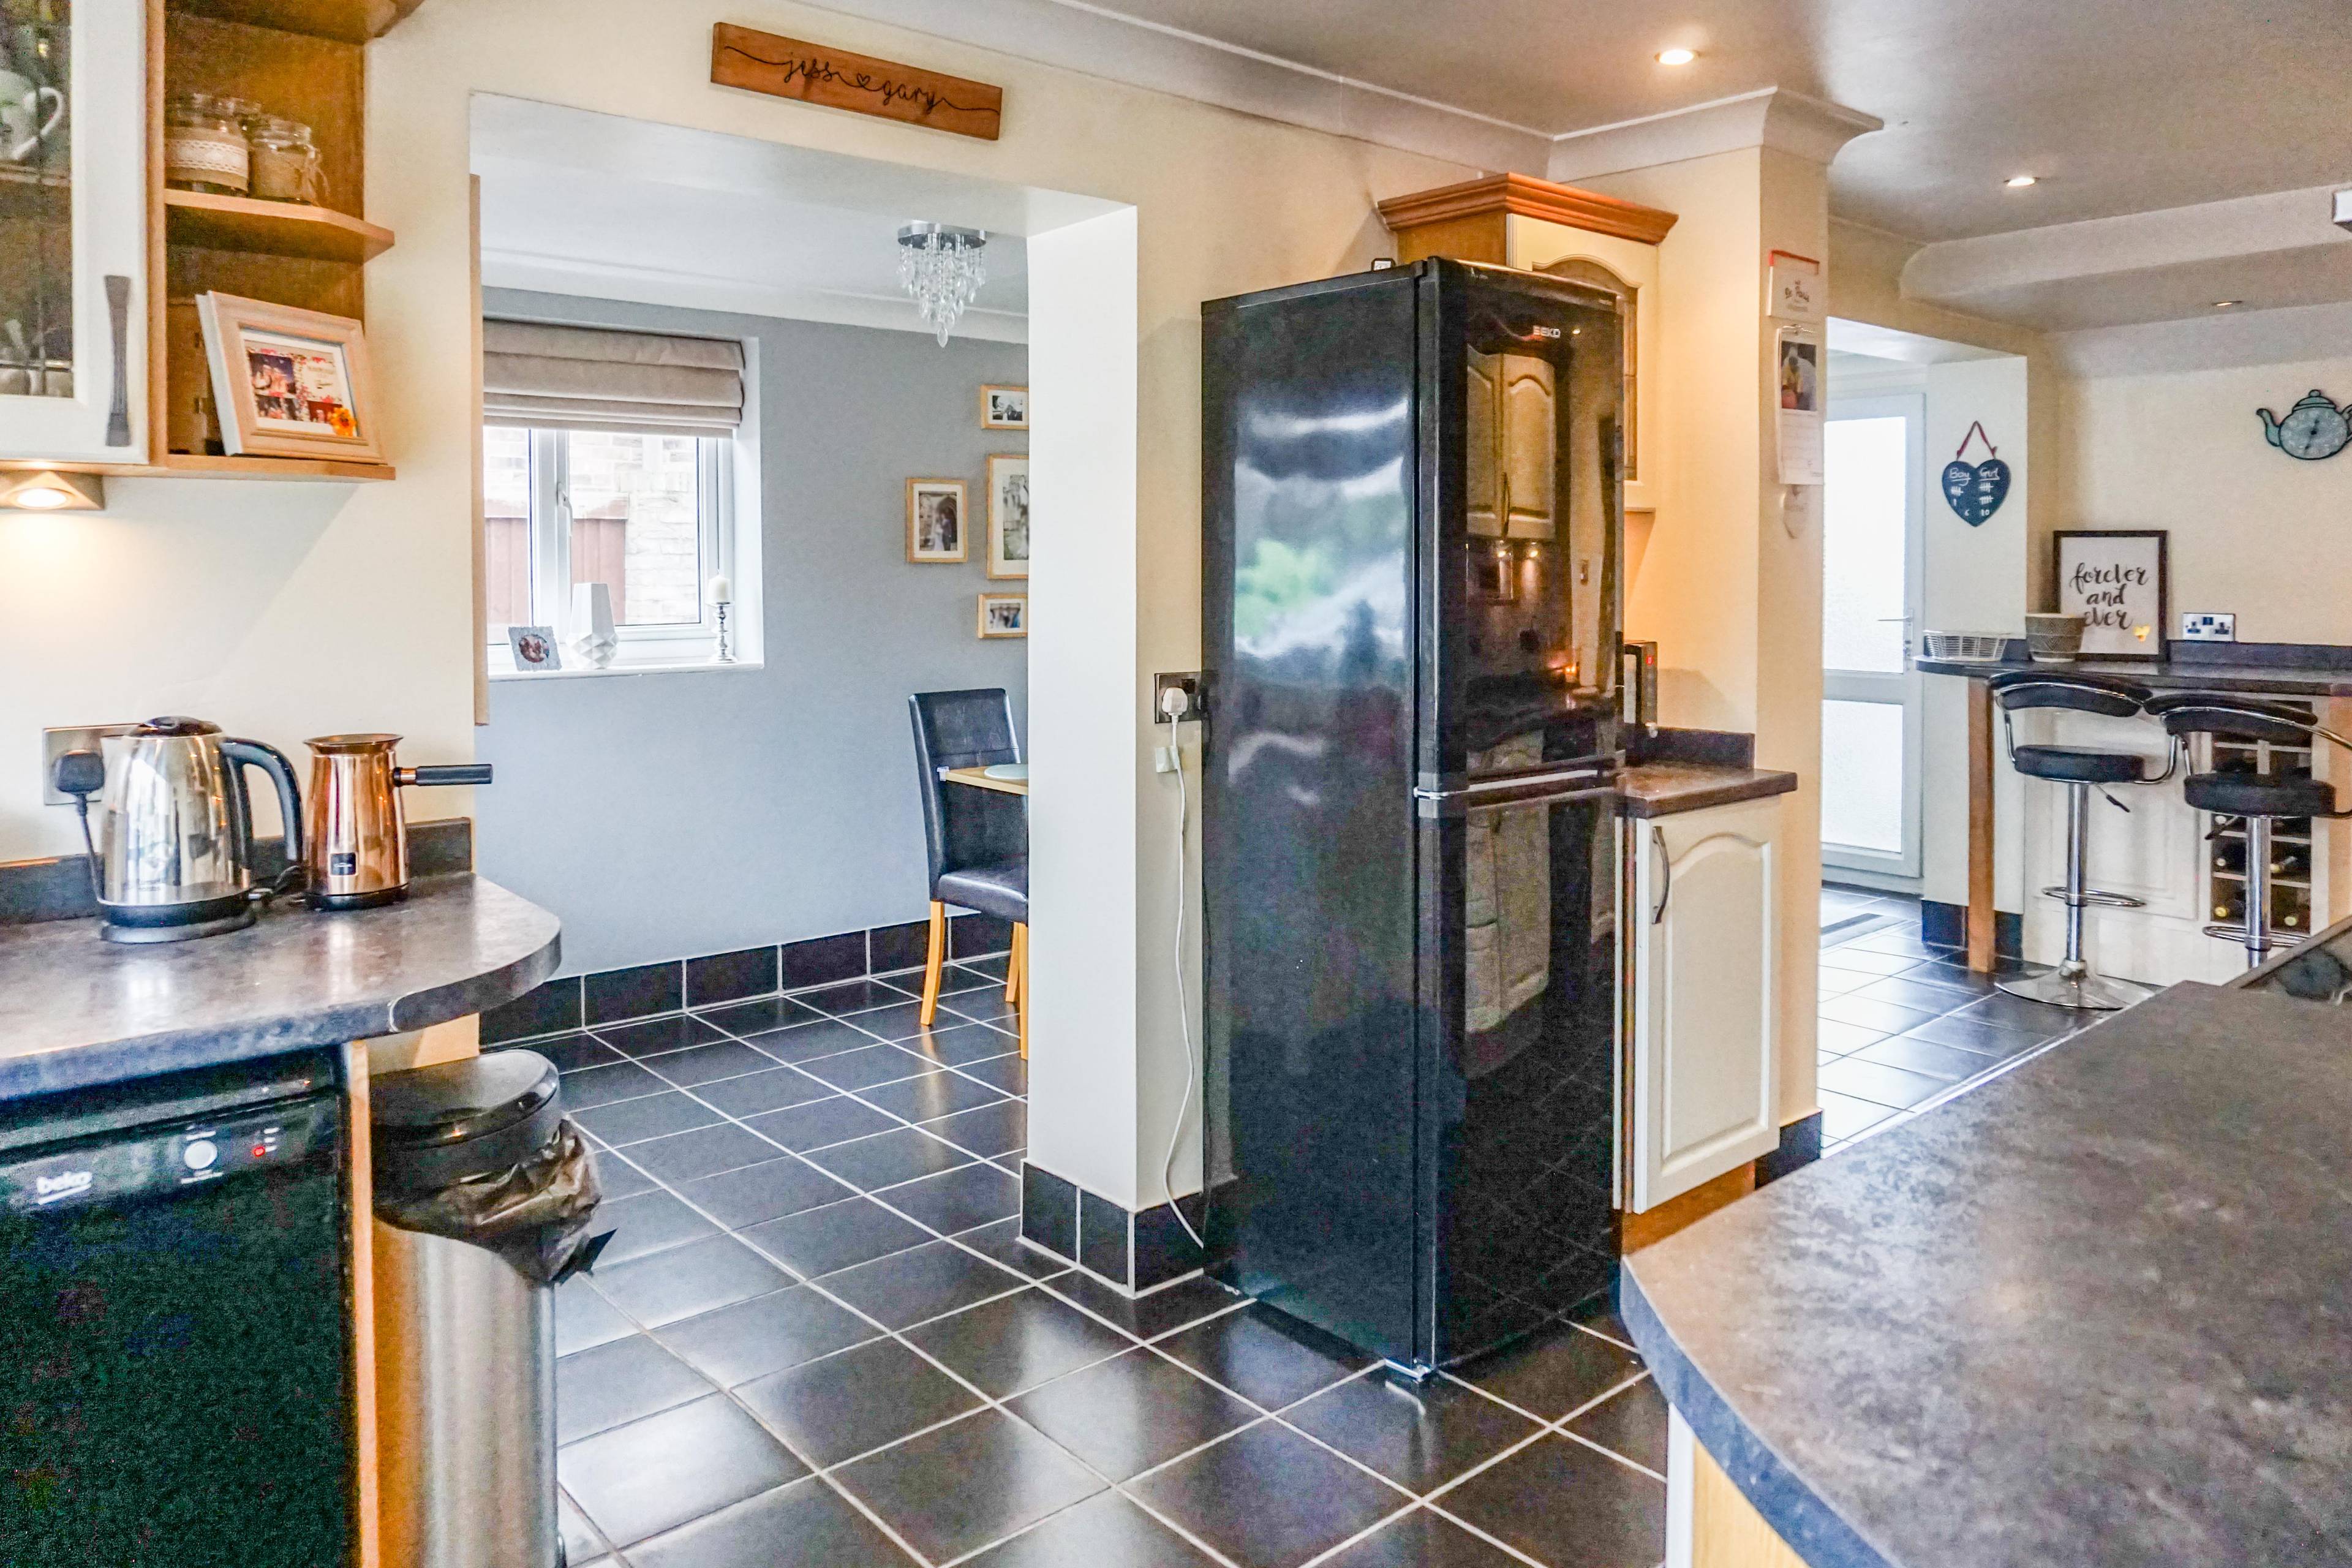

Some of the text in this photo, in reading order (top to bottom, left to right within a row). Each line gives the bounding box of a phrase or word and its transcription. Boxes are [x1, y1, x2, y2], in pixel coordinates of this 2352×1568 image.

[883, 80, 944, 115] gary
[1950, 467, 1970, 486] Boy
[2086, 583, 2127, 606] and
